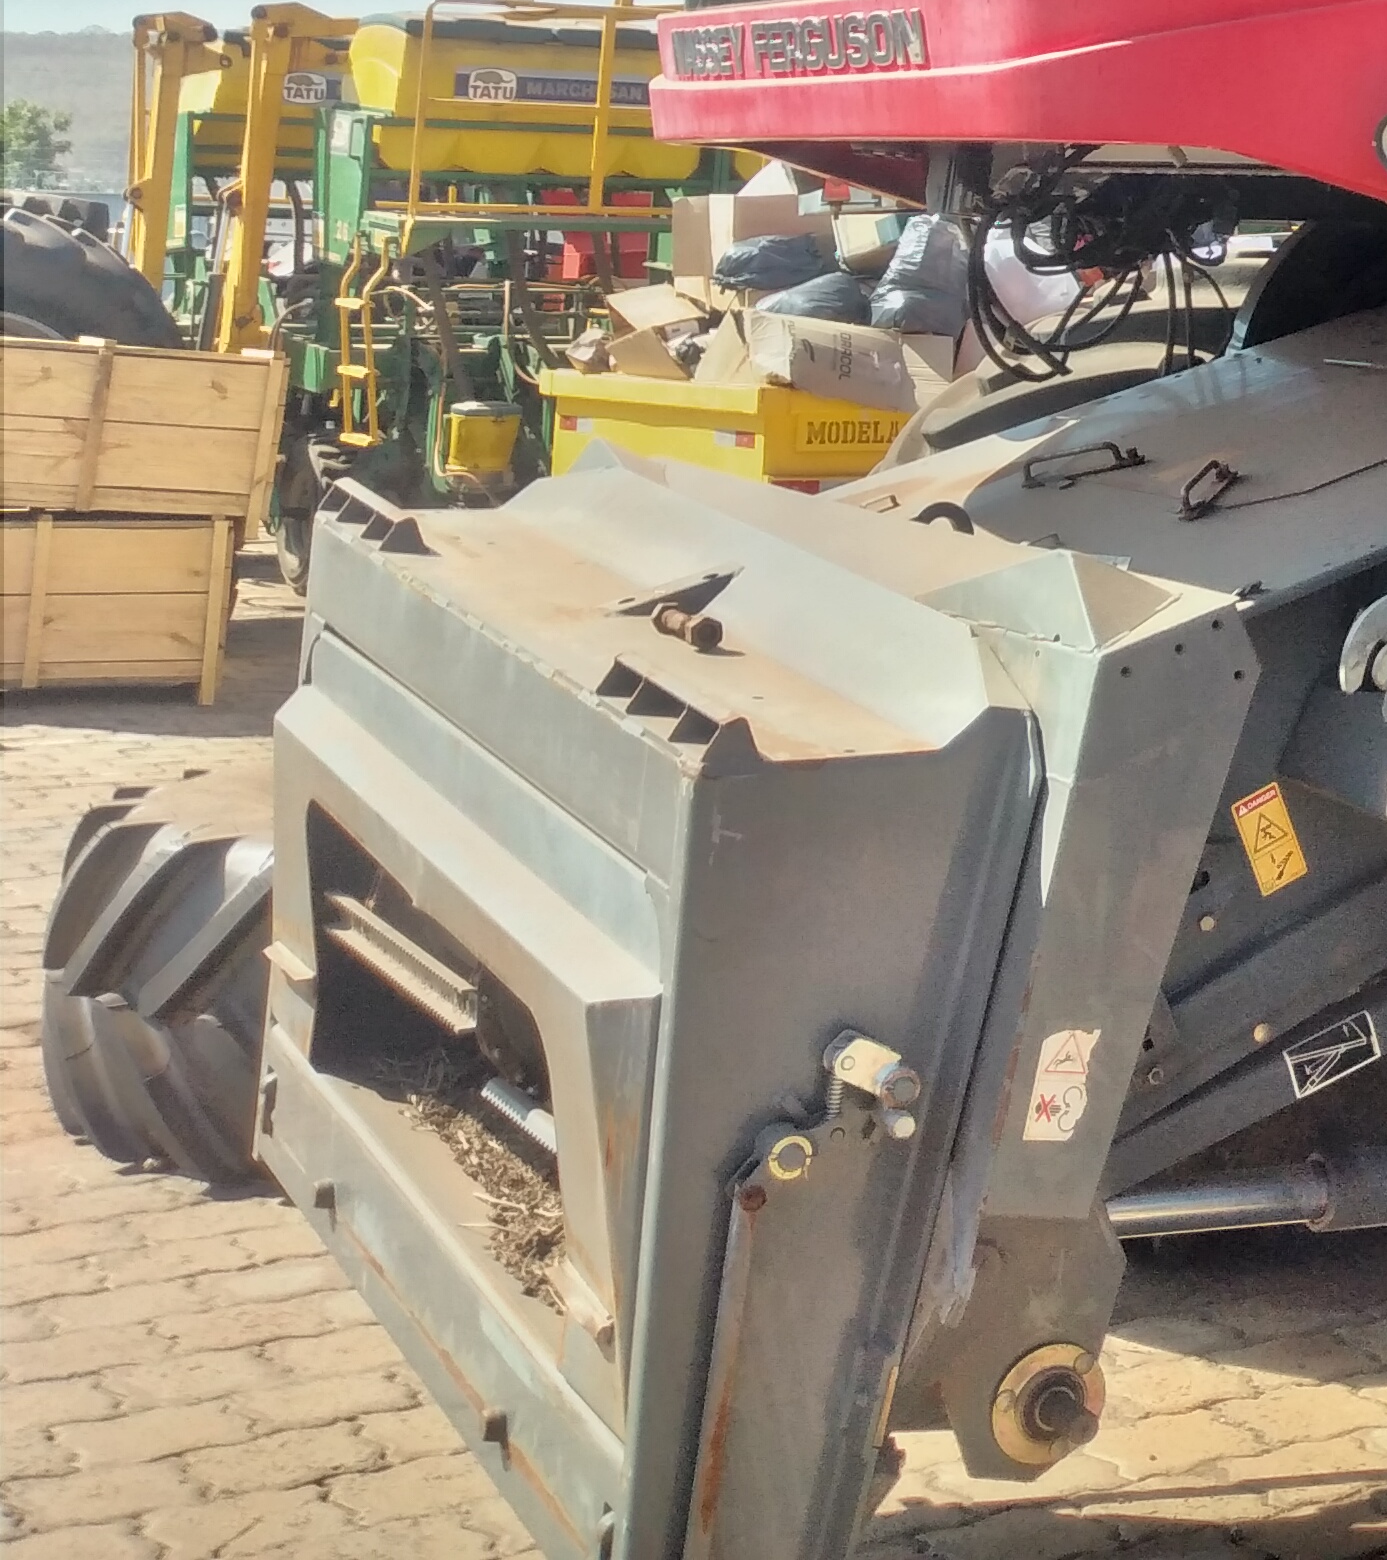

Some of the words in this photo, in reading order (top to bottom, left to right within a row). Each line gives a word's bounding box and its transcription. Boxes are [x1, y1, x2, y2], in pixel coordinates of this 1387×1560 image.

[671, 22, 745, 77] MASSEY
[750, 7, 926, 73] FERGUSON
[284, 86, 325, 100] TATU
[470, 84, 515, 100] TATU
[526, 81, 644, 100] MARCHSAN
[1246, 789, 1277, 810] DANGER
